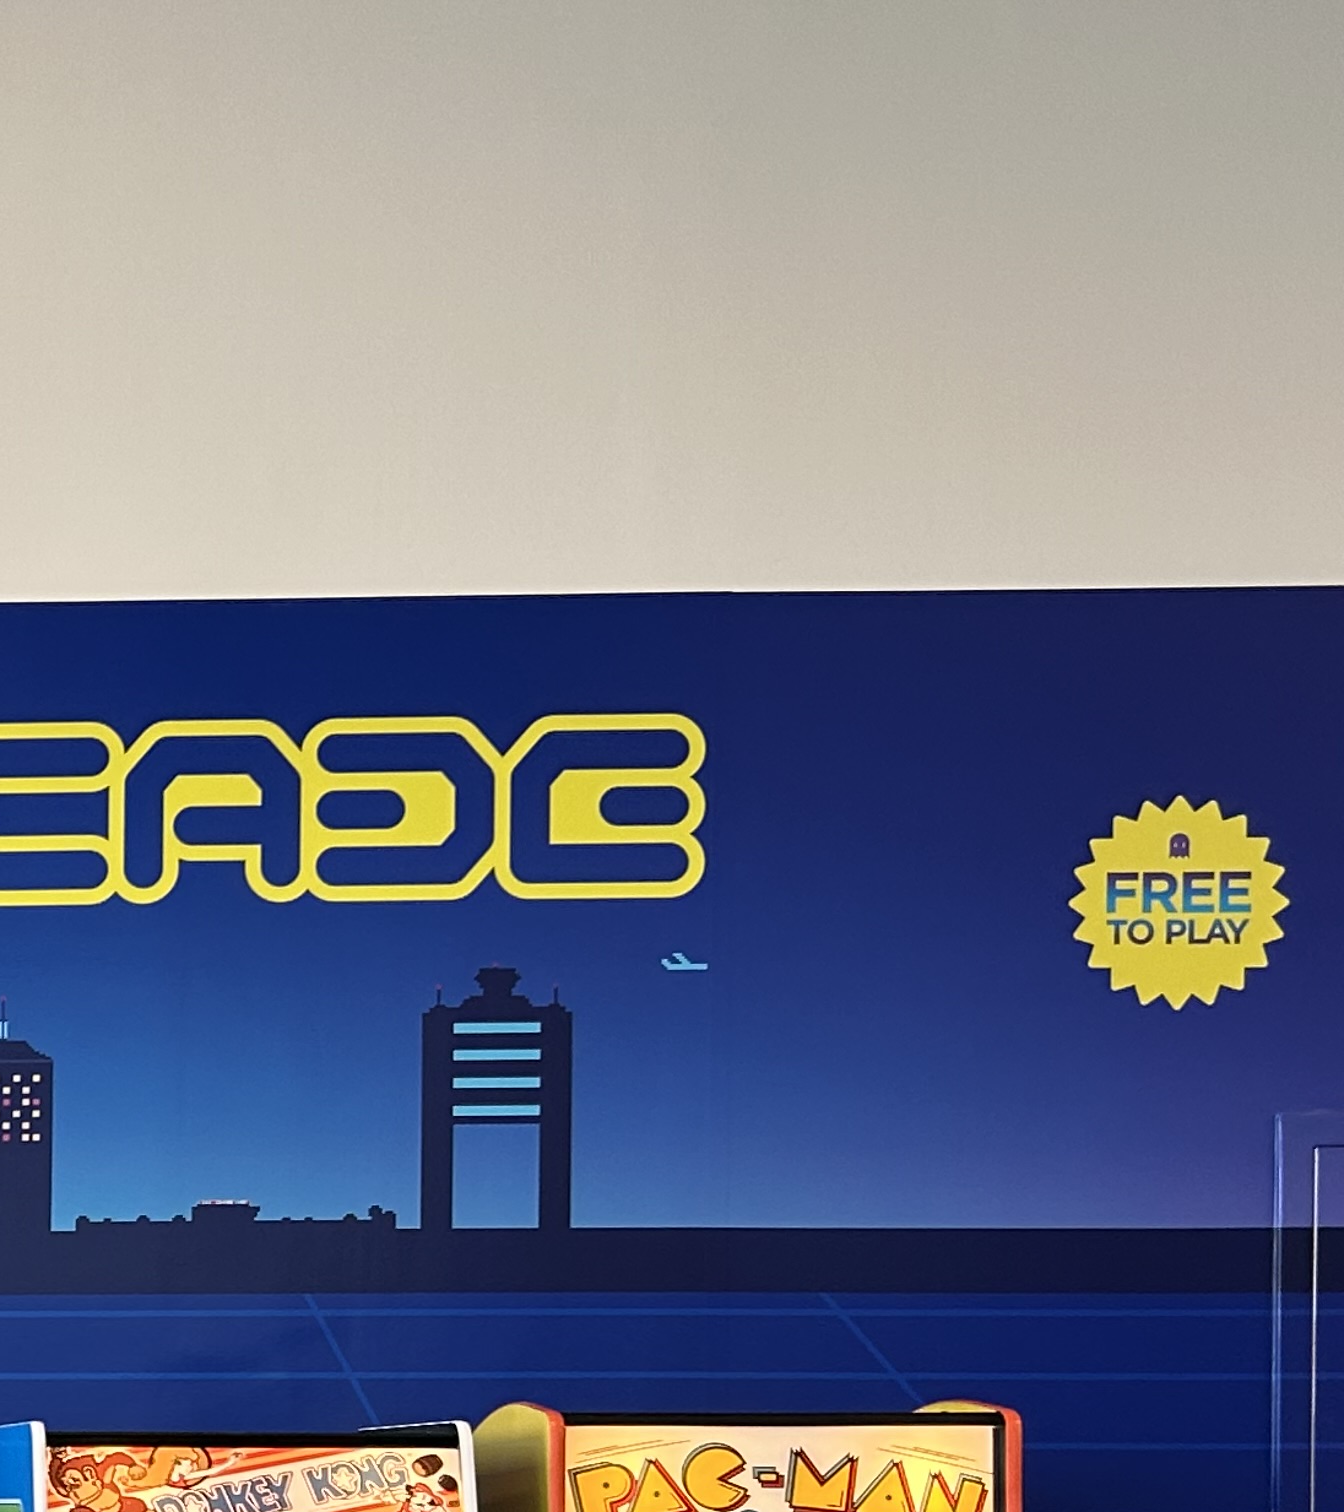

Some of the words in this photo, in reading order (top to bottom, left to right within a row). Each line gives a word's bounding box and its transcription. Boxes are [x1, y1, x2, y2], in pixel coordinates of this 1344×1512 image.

[1106, 871, 1252, 913] FREE
[1106, 920, 1154, 945] TO
[1165, 918, 1250, 945] PLAY
[302, 1452, 410, 1505] KONG
